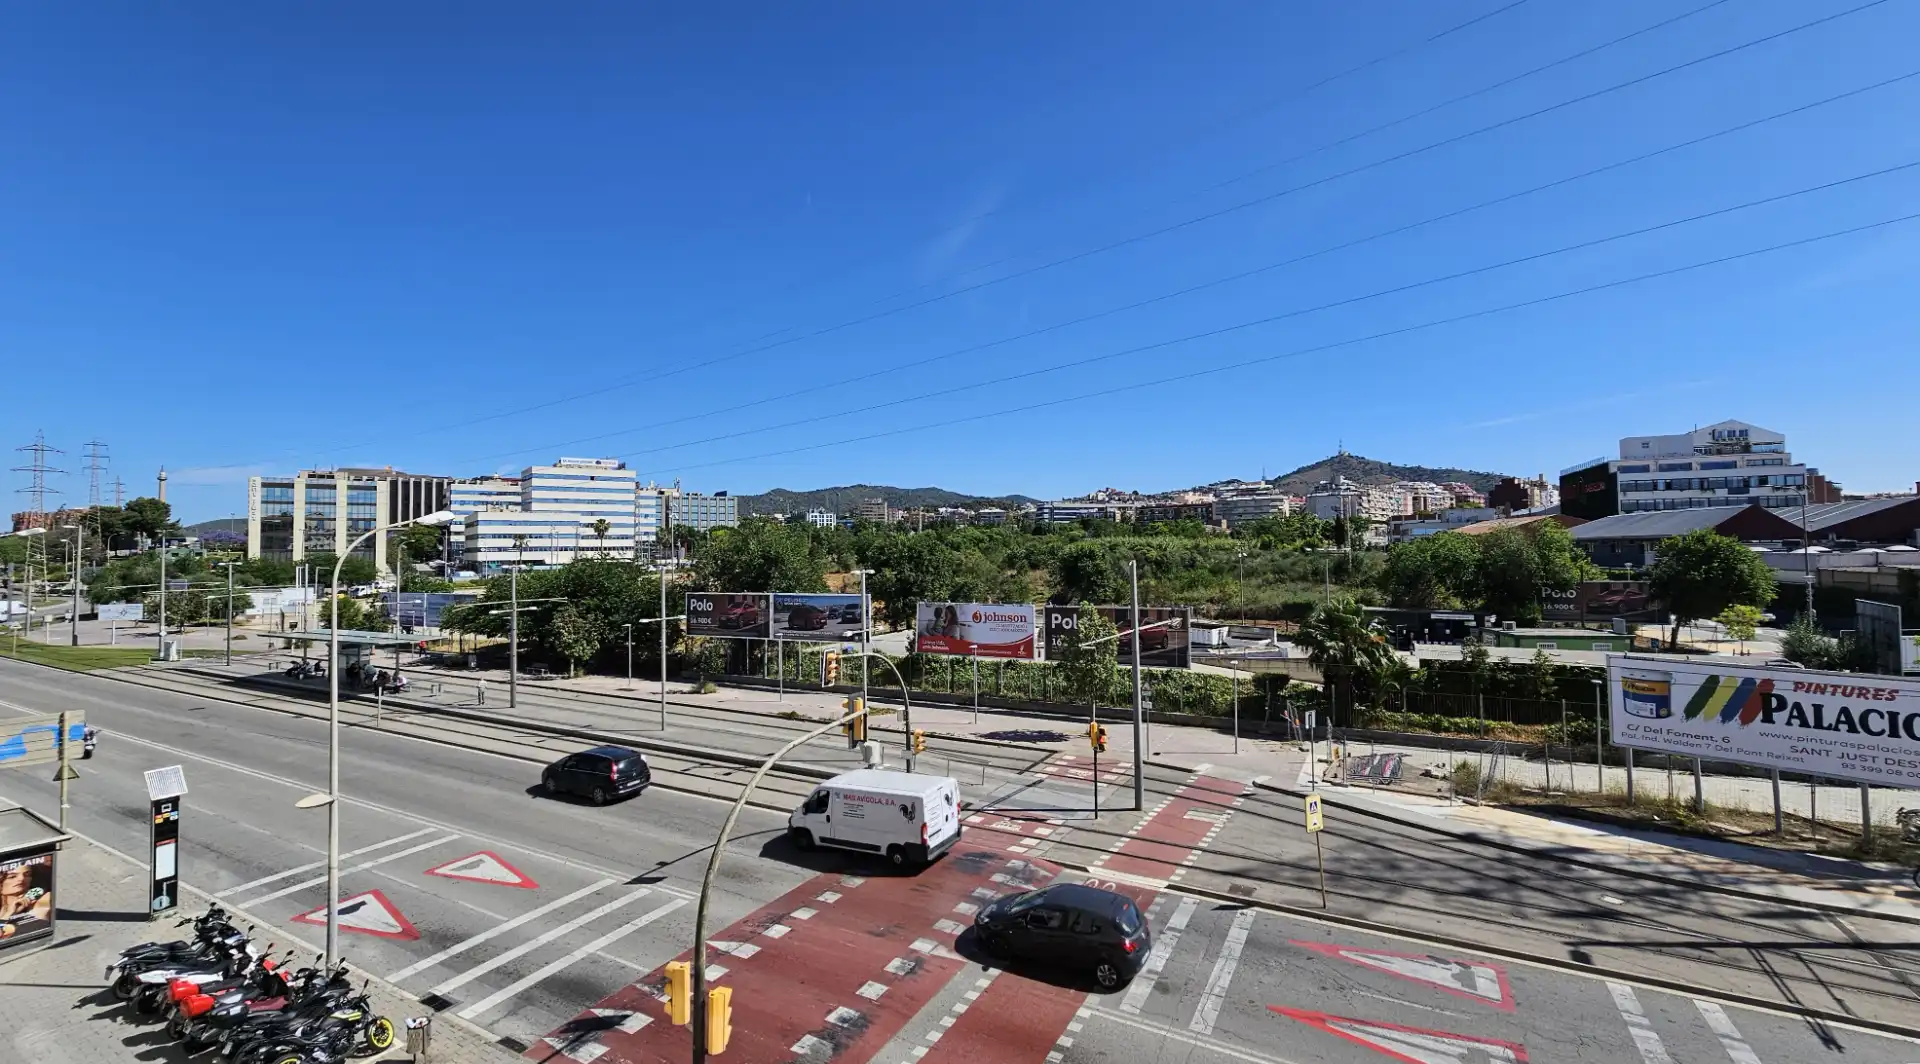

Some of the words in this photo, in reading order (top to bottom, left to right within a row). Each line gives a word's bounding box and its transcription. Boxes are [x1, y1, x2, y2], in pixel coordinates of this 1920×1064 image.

[690, 599, 714, 611] Polo
[983, 611, 1027, 624] johnson
[1051, 613, 1078, 629] Pol
[1793, 681, 1899, 701] PINTURES
[1627, 723, 1640, 731] C/
[1643, 725, 1663, 735] Del
[1722, 736, 1731, 744] 6
[1663, 737, 1702, 748] Walden
[1715, 744, 1733, 753] Del
[1736, 747, 1763, 757] Pont
[1789, 745, 1833, 758] SANT
[1836, 751, 1880, 764] JUST
[1884, 757, 1920, 770] DES
[0, 856, 45, 872] ERLAIN
